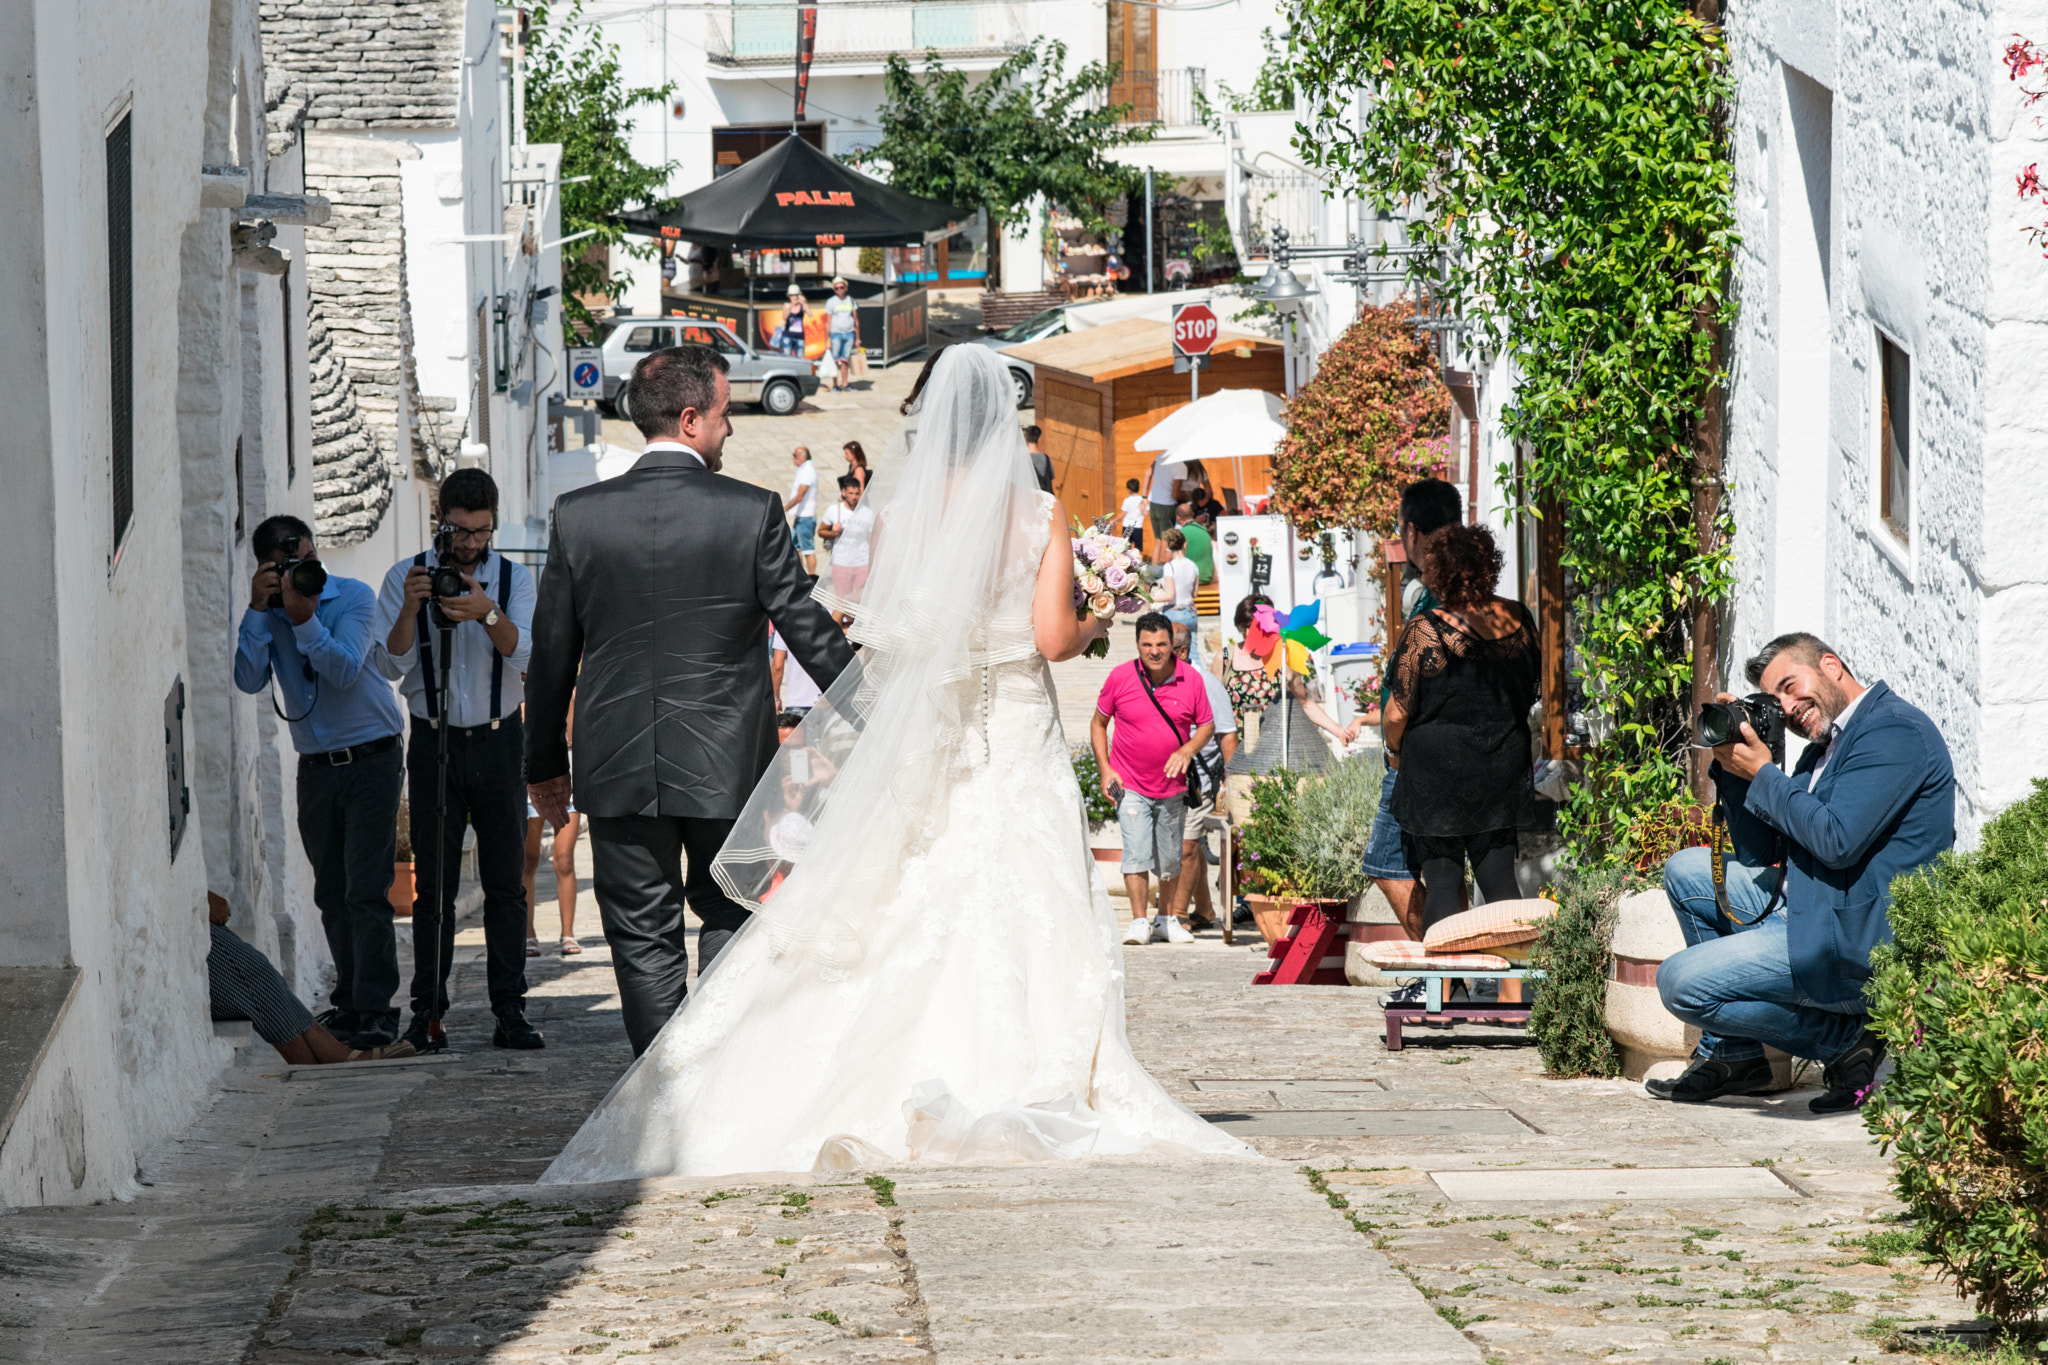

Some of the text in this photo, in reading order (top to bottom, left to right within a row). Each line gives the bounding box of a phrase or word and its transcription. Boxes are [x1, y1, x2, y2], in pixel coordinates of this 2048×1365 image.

[775, 190, 855, 207] PALM
[816, 233, 845, 245] PALM
[892, 306, 922, 344] PALM
[1176, 319, 1216, 340] STOP
[1713, 855, 1723, 883] D750
